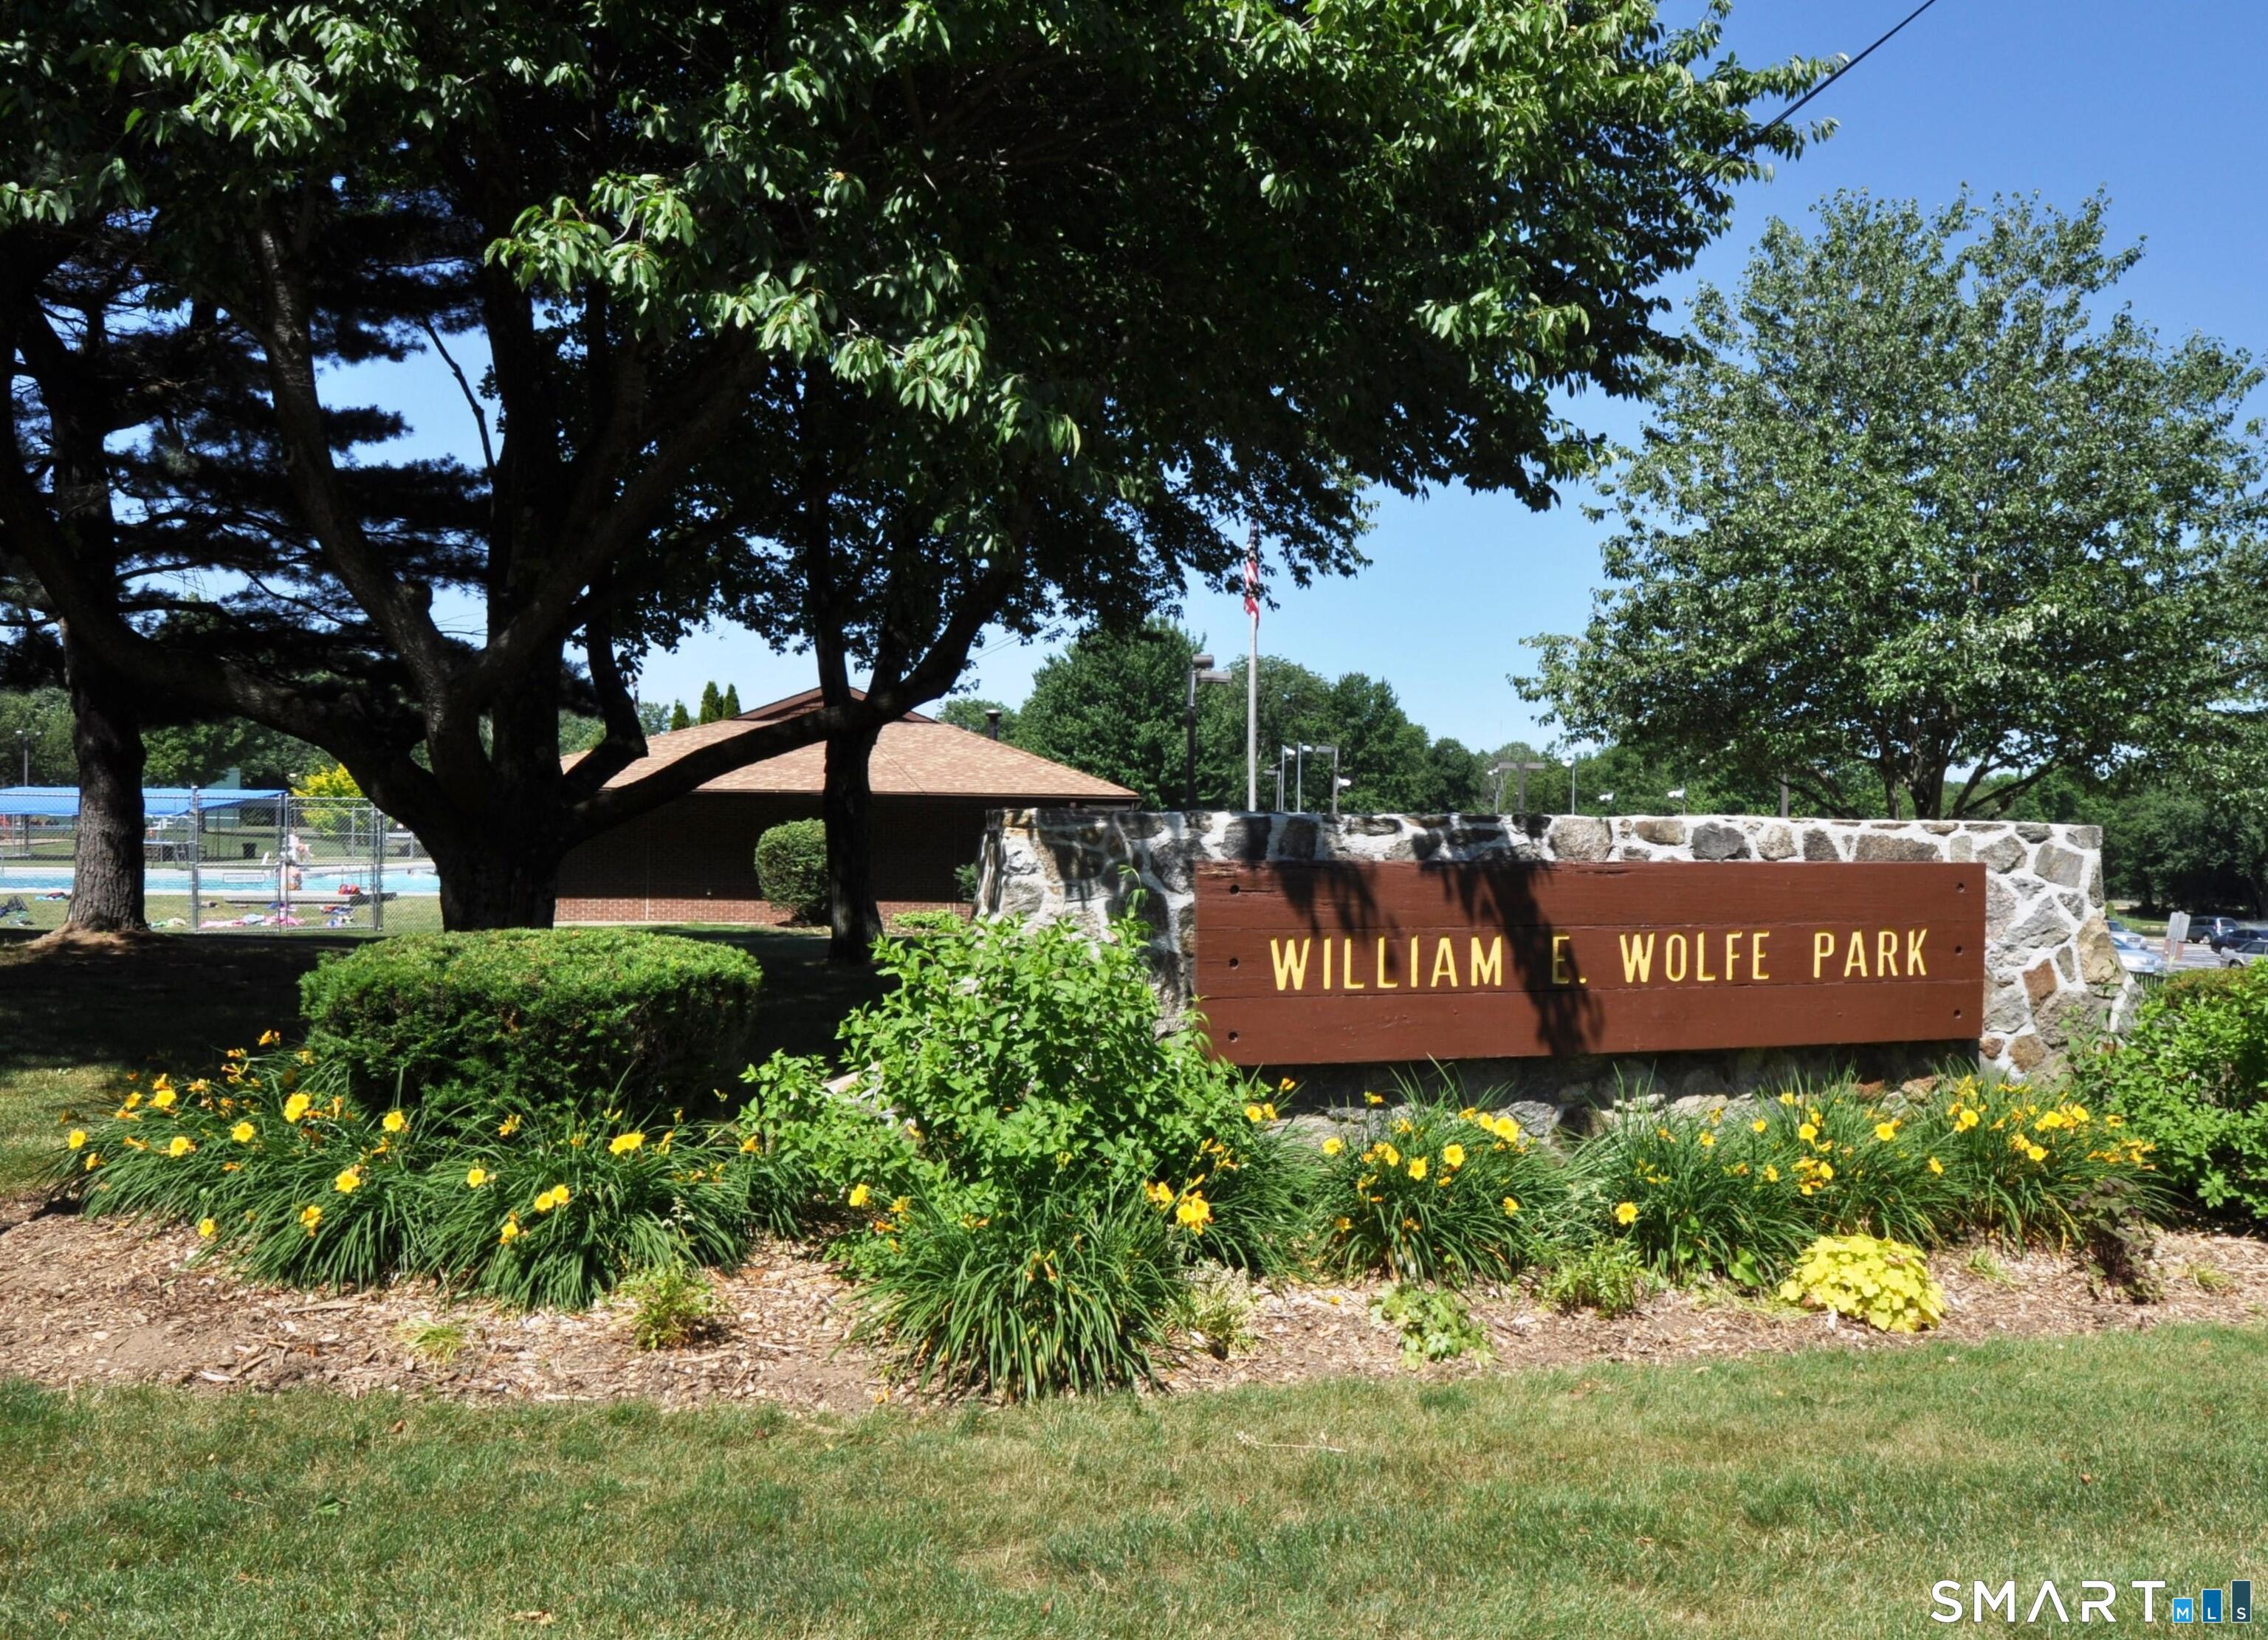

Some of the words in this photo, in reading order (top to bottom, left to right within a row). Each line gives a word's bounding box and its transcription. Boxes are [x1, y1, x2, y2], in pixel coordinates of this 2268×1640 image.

[1268, 933, 1505, 992] WILLIAM
[1551, 933, 1587, 985] E.
[1618, 928, 1772, 986] WOLFE
[1812, 927, 1929, 980] PARK
